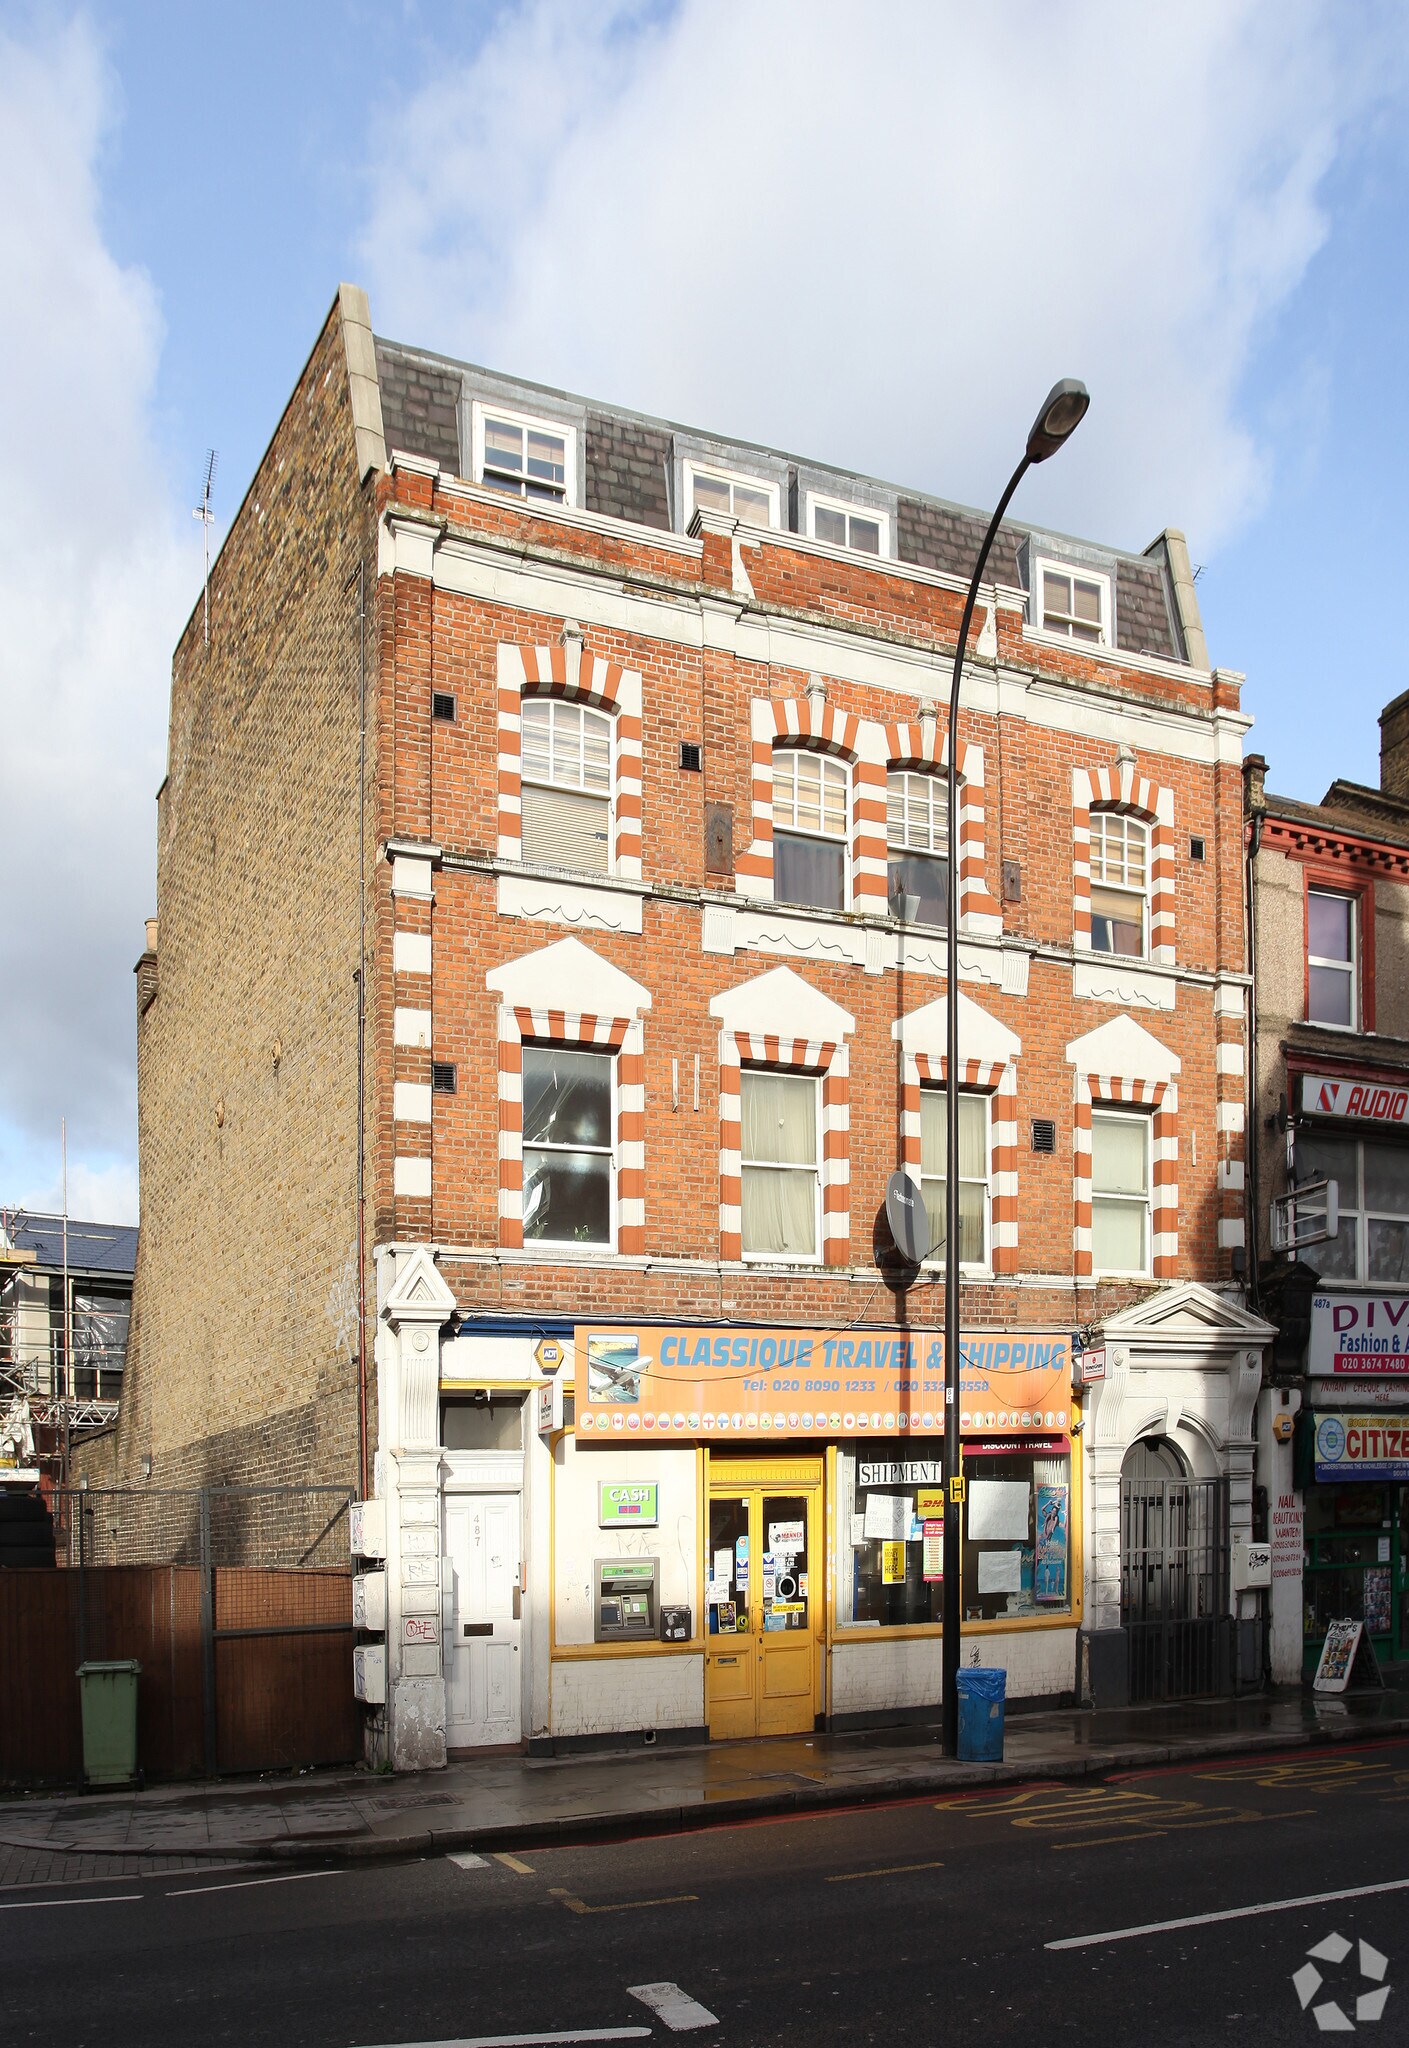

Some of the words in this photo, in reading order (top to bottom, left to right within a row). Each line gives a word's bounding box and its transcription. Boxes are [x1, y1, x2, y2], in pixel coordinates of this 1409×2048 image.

[1347, 1086, 1408, 1120] AUDIO
[1314, 1298, 1330, 1309] 487a
[1333, 1301, 1409, 1332] DIV
[1340, 1332, 1388, 1352] Fashion
[1392, 1334, 1400, 1353] &
[543, 1349, 557, 1359] ADT
[660, 1336, 813, 1370] CLASSIQUE
[822, 1341, 917, 1369] TRAVEL
[926, 1341, 943, 1369] &
[1342, 1358, 1358, 1369] 020
[1361, 1358, 1381, 1369] 3674
[1385, 1358, 1405, 1369] 7480
[742, 1380, 767, 1391] Tel:
[773, 1380, 800, 1392] 020
[805, 1380, 840, 1392] 8090
[845, 1380, 875, 1392] 1233
[893, 1380, 918, 1392] 020
[923, 1380, 946, 1392] 332
[959, 1380, 989, 1392] 8558
[1024, 1441, 1053, 1449] TRAVEL
[861, 1463, 939, 1483] SHIPMENT
[609, 1488, 650, 1502] CASH
[1278, 1495, 1295, 1509] NAIL
